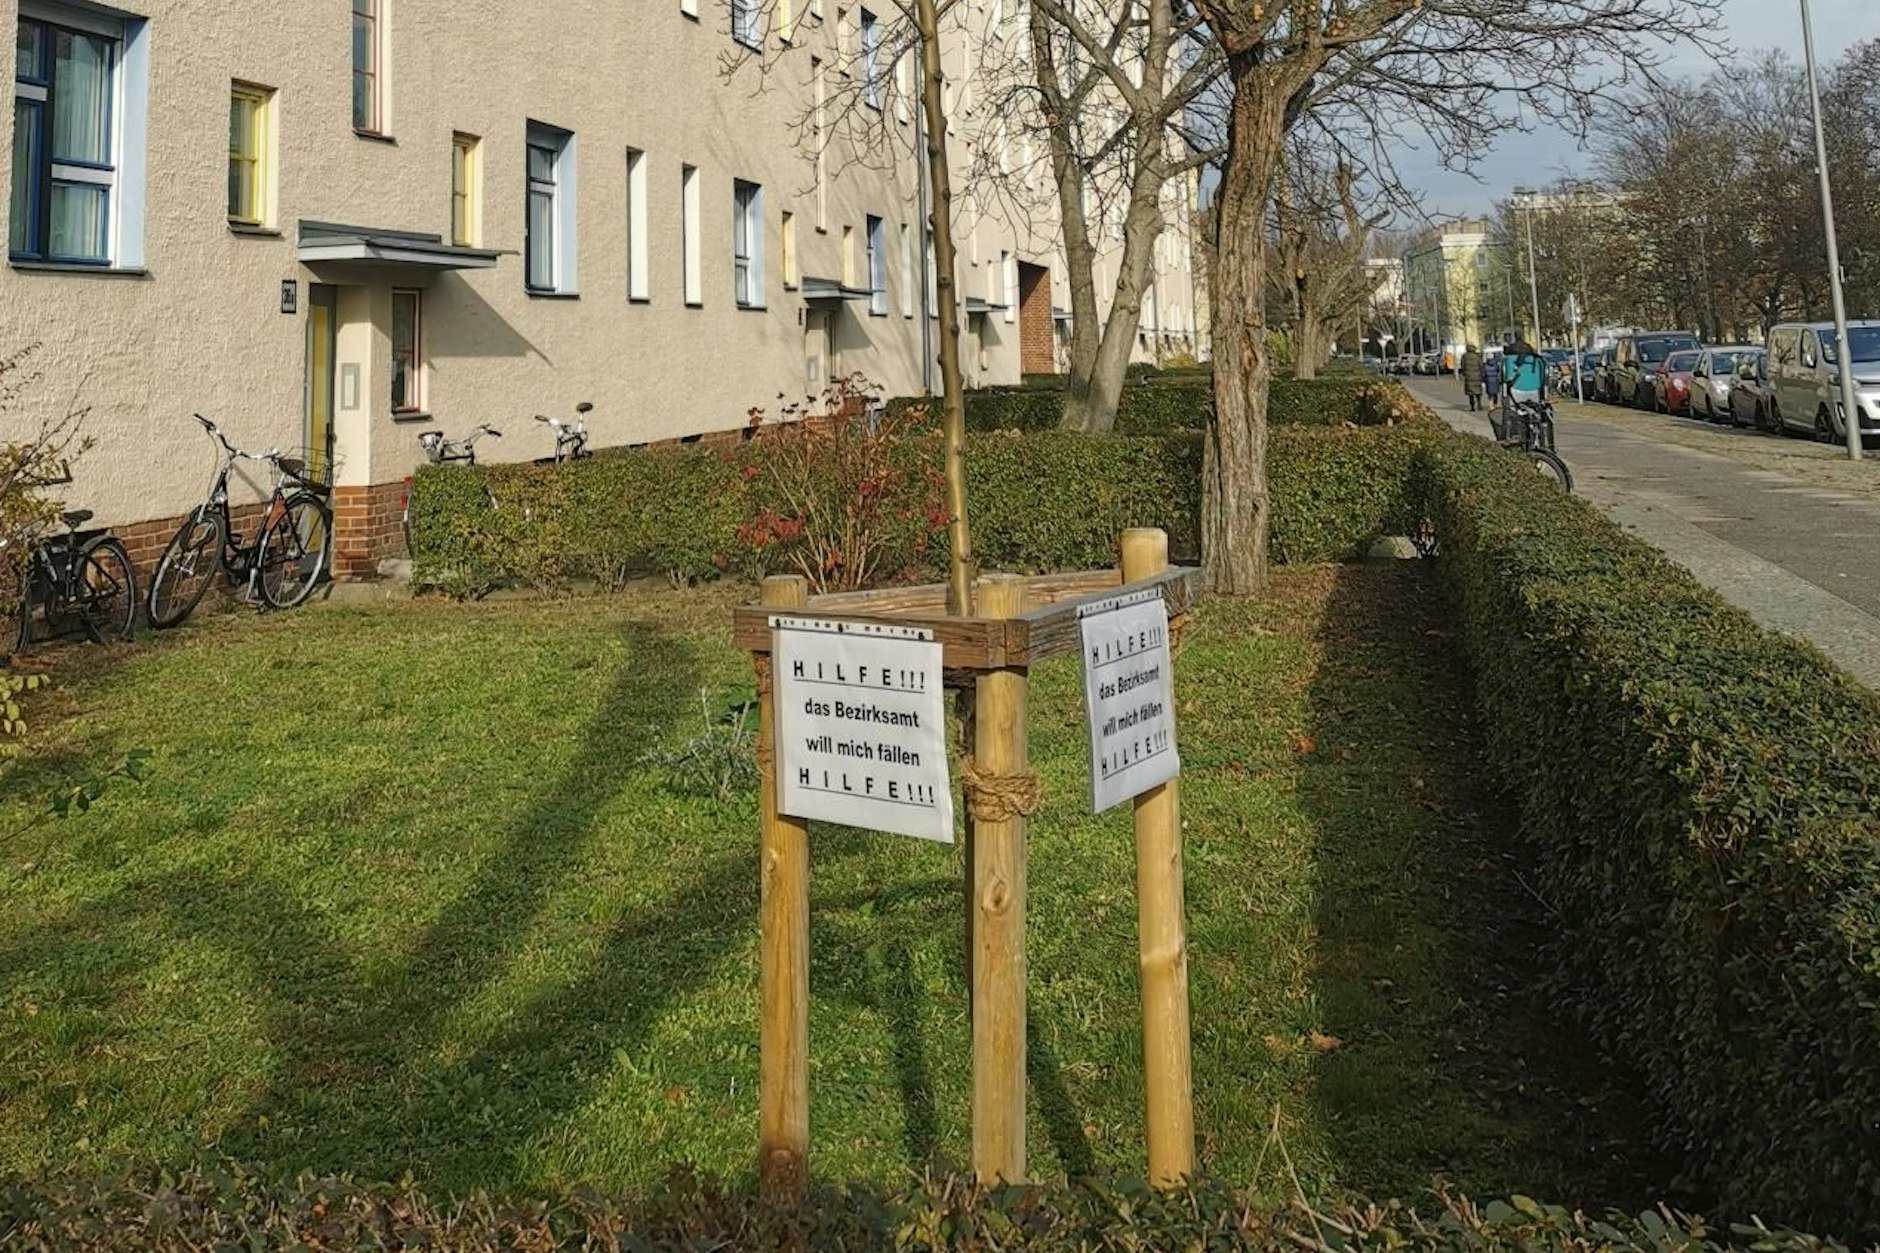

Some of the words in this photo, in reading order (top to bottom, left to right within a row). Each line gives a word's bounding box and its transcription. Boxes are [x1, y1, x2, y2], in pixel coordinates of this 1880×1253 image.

[793, 659, 925, 689] HILFE!!!
[1098, 681, 1116, 701] das
[1117, 666, 1160, 695] Bezirksamt
[804, 698, 831, 717] das
[835, 701, 920, 728] Bezirksamt
[1102, 717, 1118, 739] will
[1118, 708, 1139, 733] mich
[1140, 701, 1163, 724] fällen
[805, 735, 832, 754] will
[837, 740, 873, 760] mich
[878, 743, 920, 767] fällen
[799, 767, 934, 803] HILFE!!!
